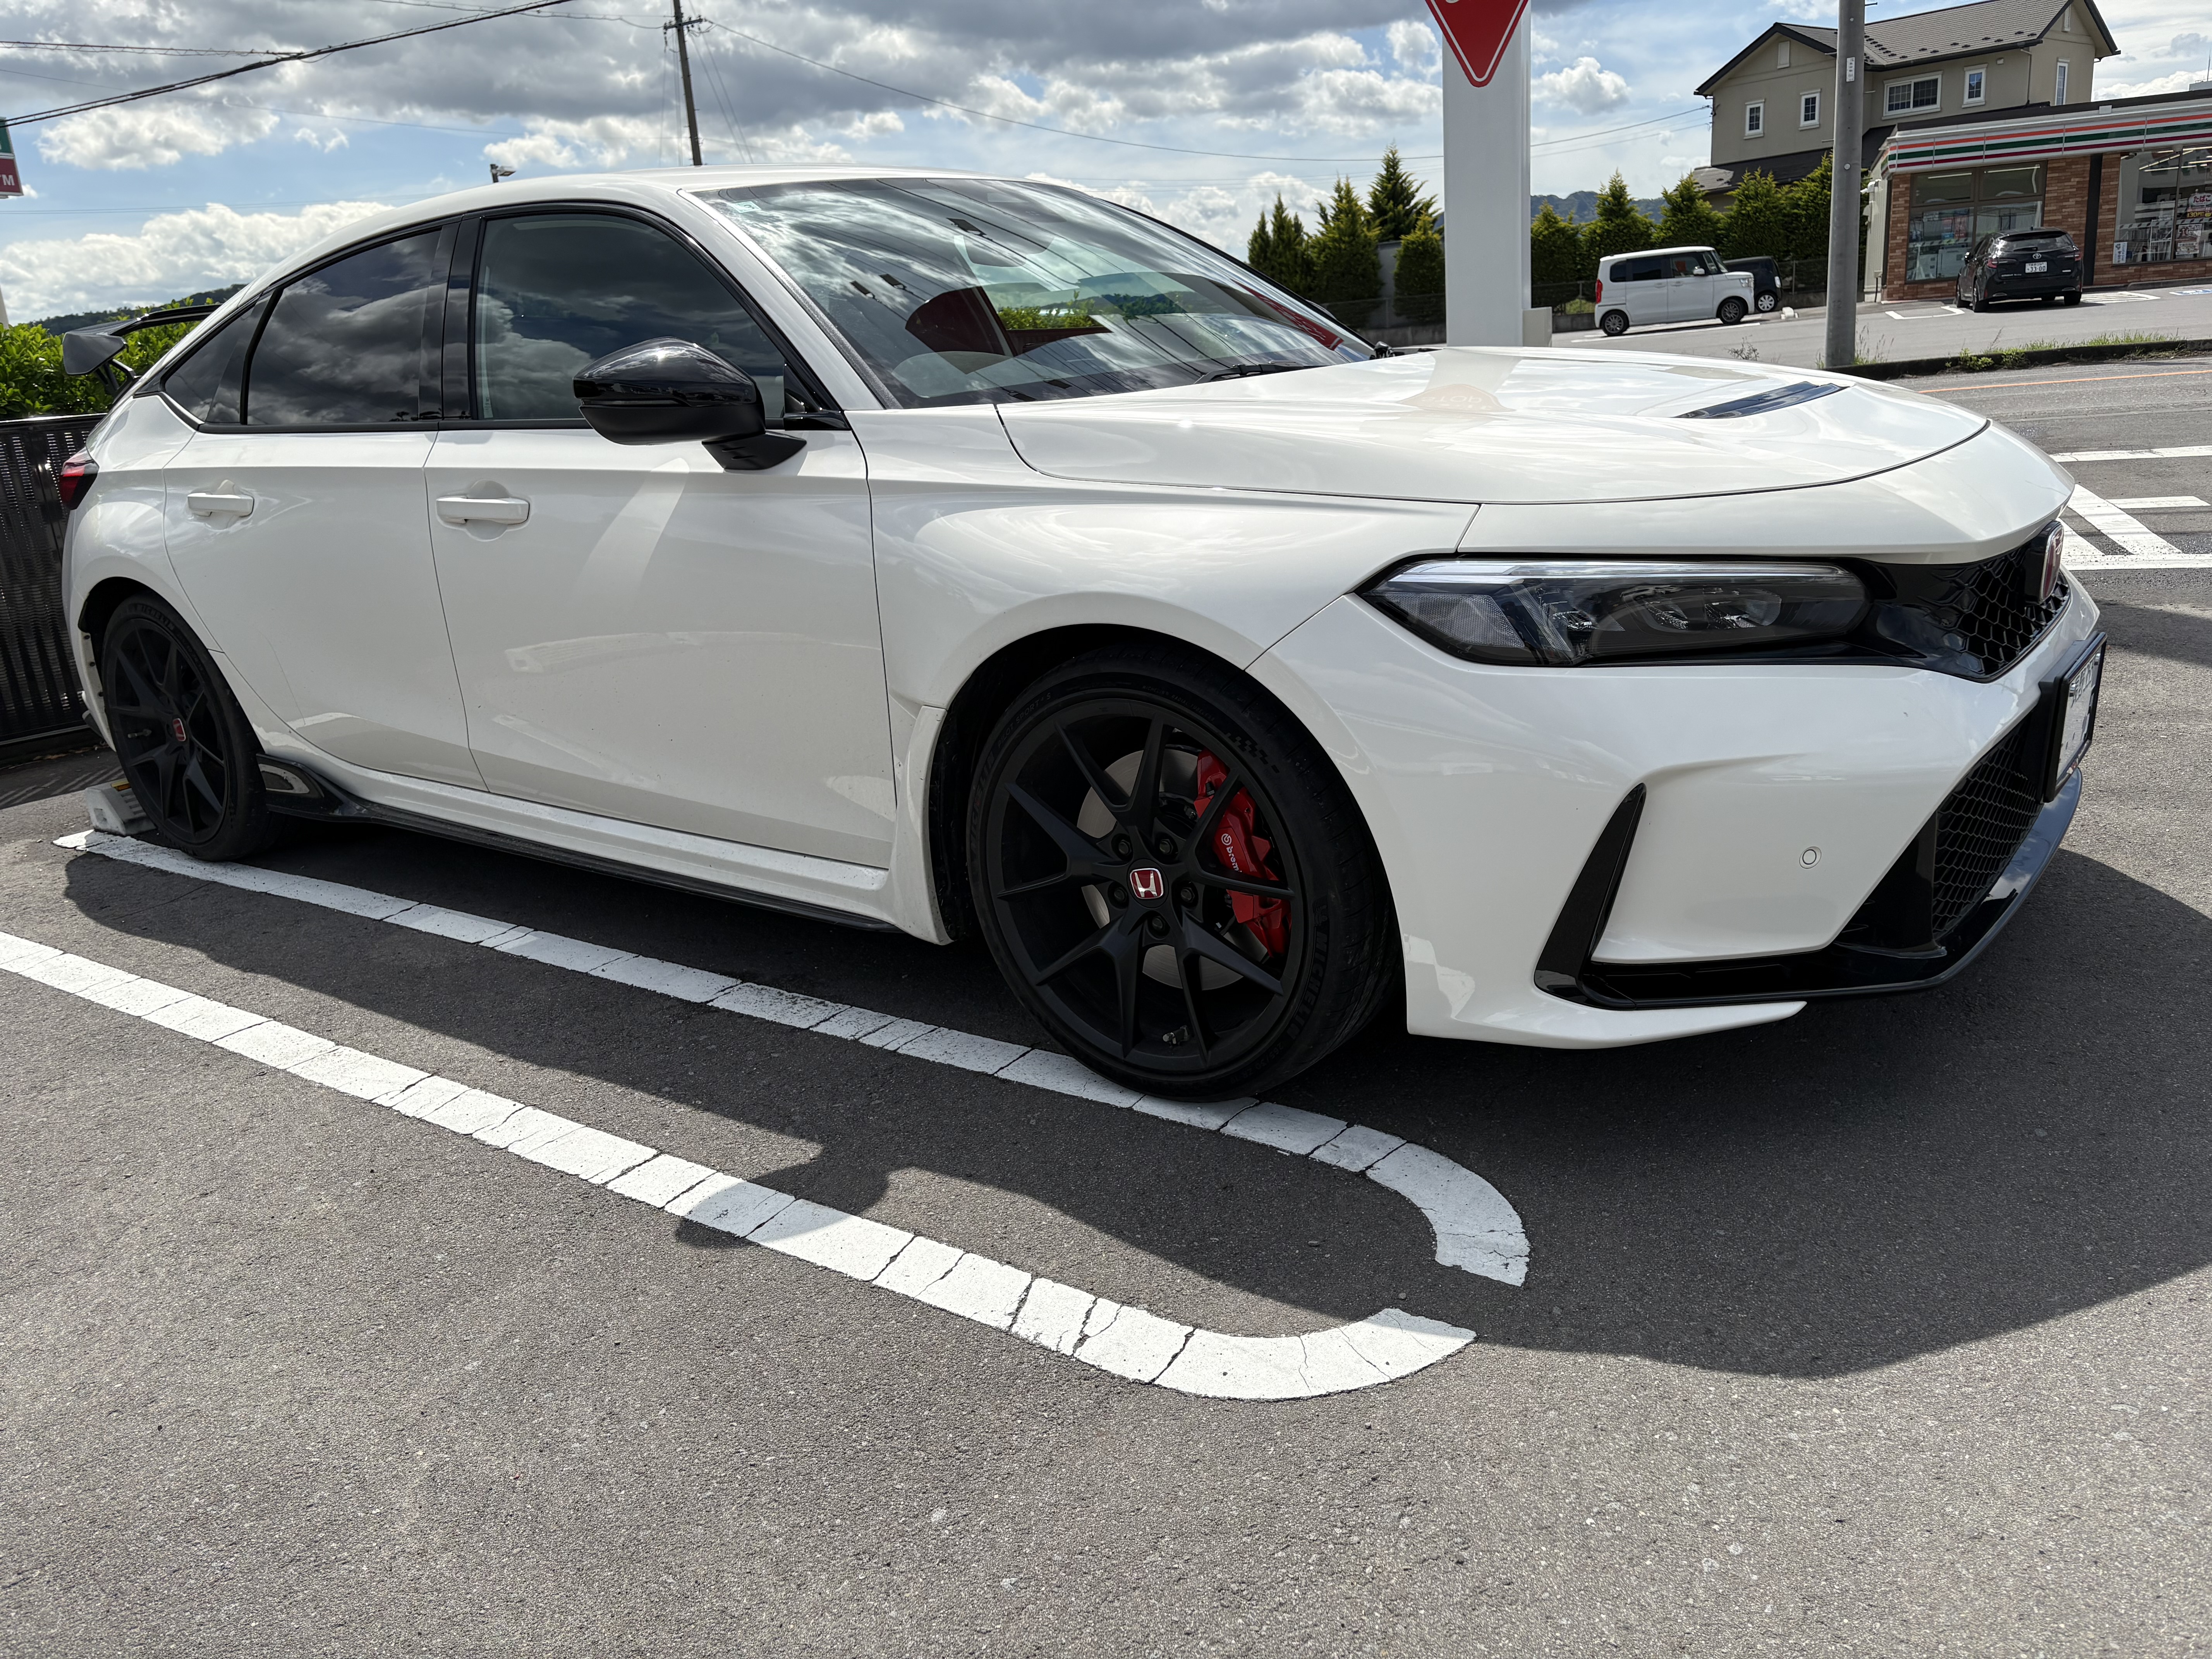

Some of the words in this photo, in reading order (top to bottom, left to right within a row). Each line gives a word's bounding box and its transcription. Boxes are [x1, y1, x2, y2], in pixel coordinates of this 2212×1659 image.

[0, 174, 15, 186] M
[2193, 195, 2211, 203] たばこ
[998, 722, 1014, 748] PILOT
[1016, 699, 1040, 724] SPORT
[1226, 845, 1242, 872] brem
[1287, 932, 1328, 1041] MICHELIN
